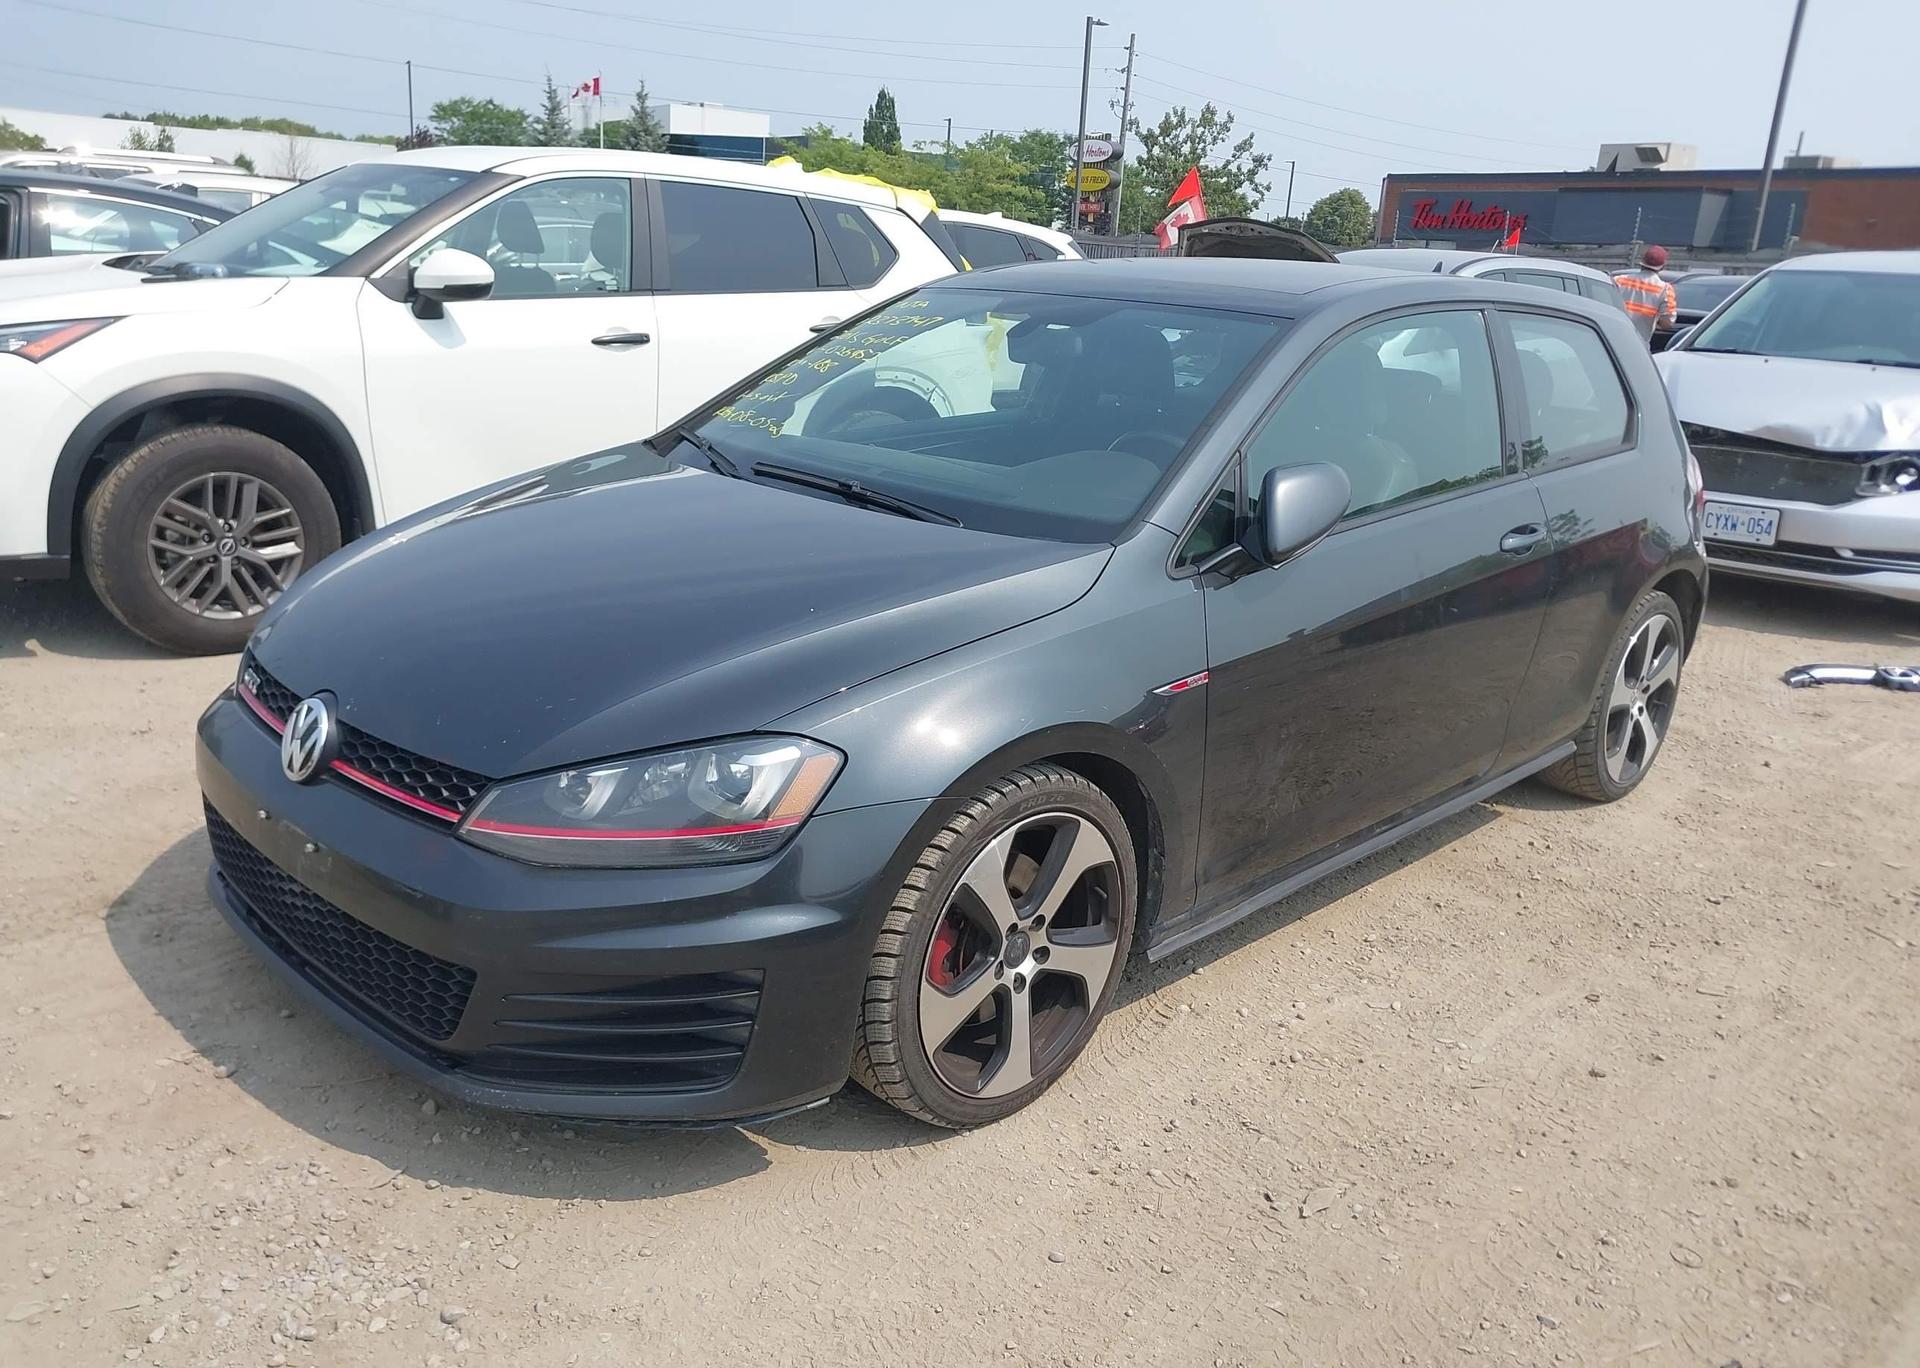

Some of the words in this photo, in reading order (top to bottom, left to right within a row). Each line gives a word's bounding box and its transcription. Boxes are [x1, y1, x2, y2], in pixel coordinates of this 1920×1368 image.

[1411, 198, 1445, 229] Tim
[1447, 199, 1528, 231] Hortons
[1746, 516, 1774, 537] 054
